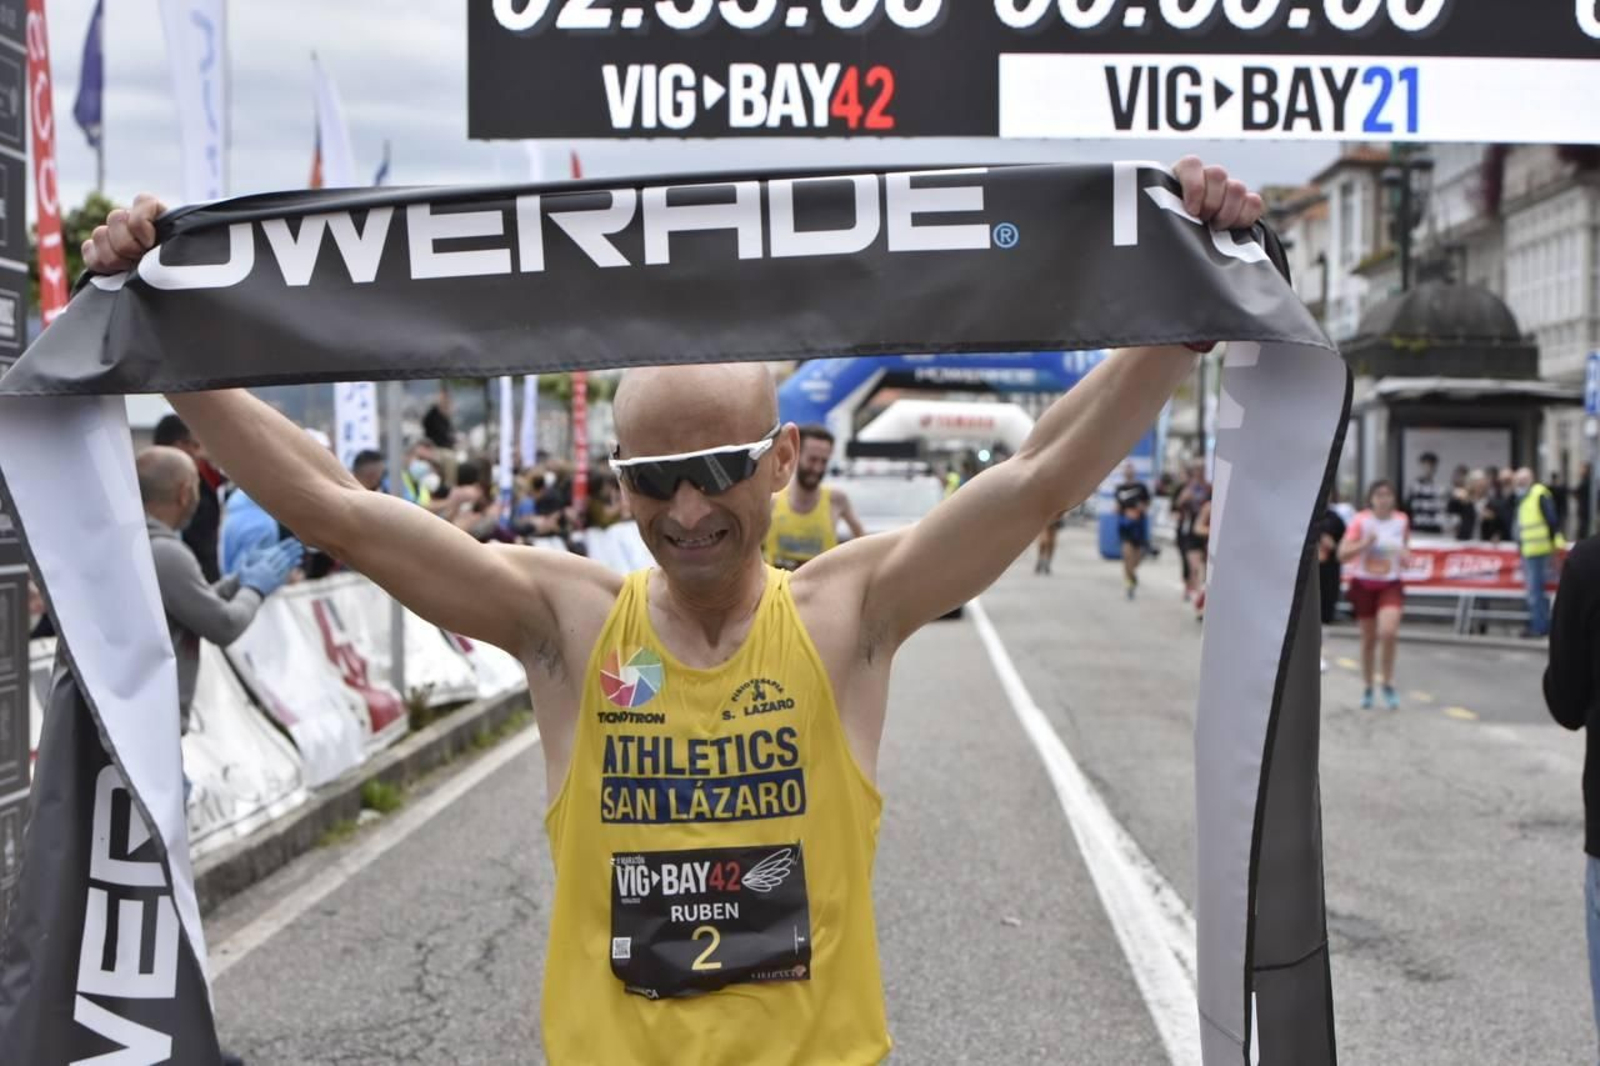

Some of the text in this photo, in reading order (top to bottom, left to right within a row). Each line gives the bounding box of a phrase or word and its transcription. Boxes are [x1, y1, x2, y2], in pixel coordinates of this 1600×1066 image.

[743, 698, 796, 717] LAZARO
[602, 726, 799, 776] ATHLETICS
[602, 779, 801, 821] SAN LÁZARO
[671, 902, 740, 922] RUBEN
[691, 925, 722, 971] 2
